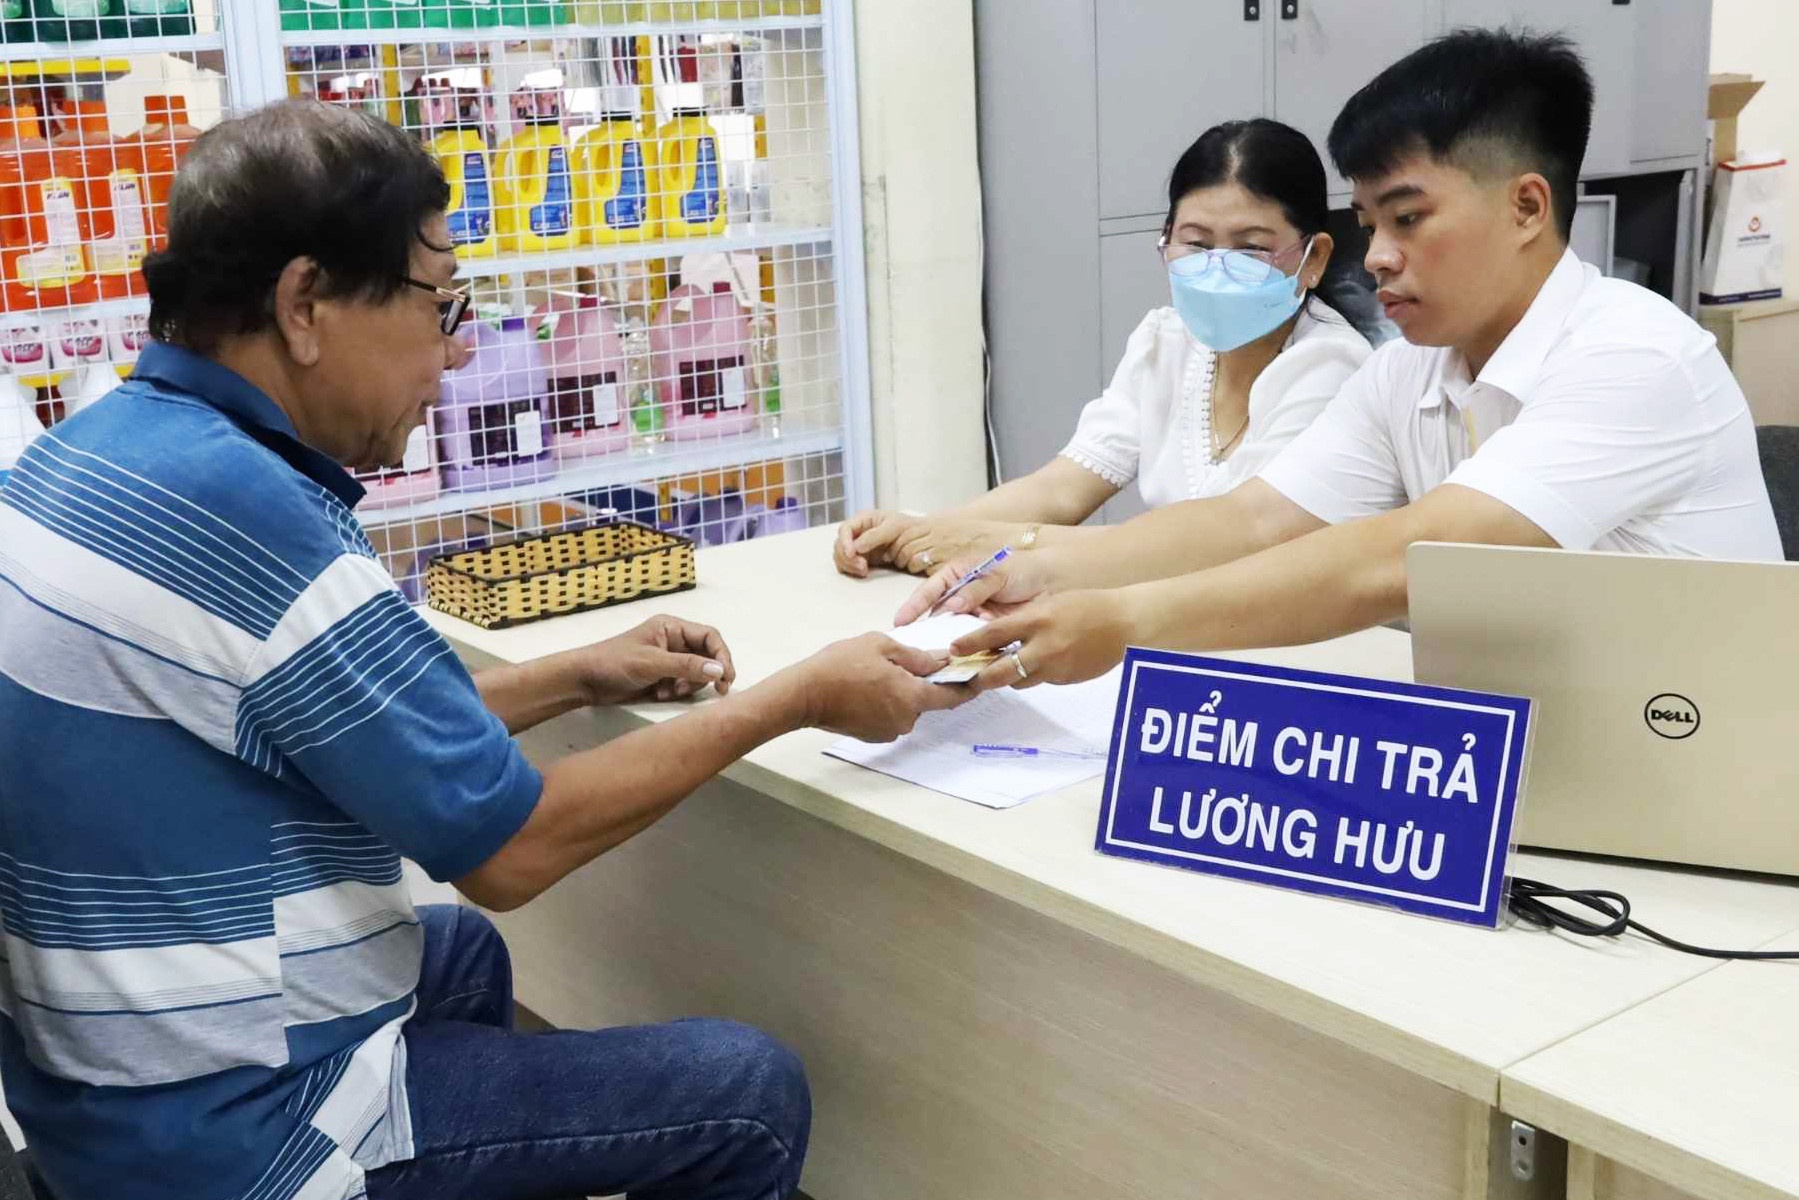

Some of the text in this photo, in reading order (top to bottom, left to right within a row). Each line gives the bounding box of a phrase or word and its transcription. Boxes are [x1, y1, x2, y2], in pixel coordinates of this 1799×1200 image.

[1141, 691, 1478, 804] ĐIỂM CHI TRẢ
[1651, 709, 1694, 723] DELL
[1149, 787, 1446, 881] LƯƠNG HƯU
